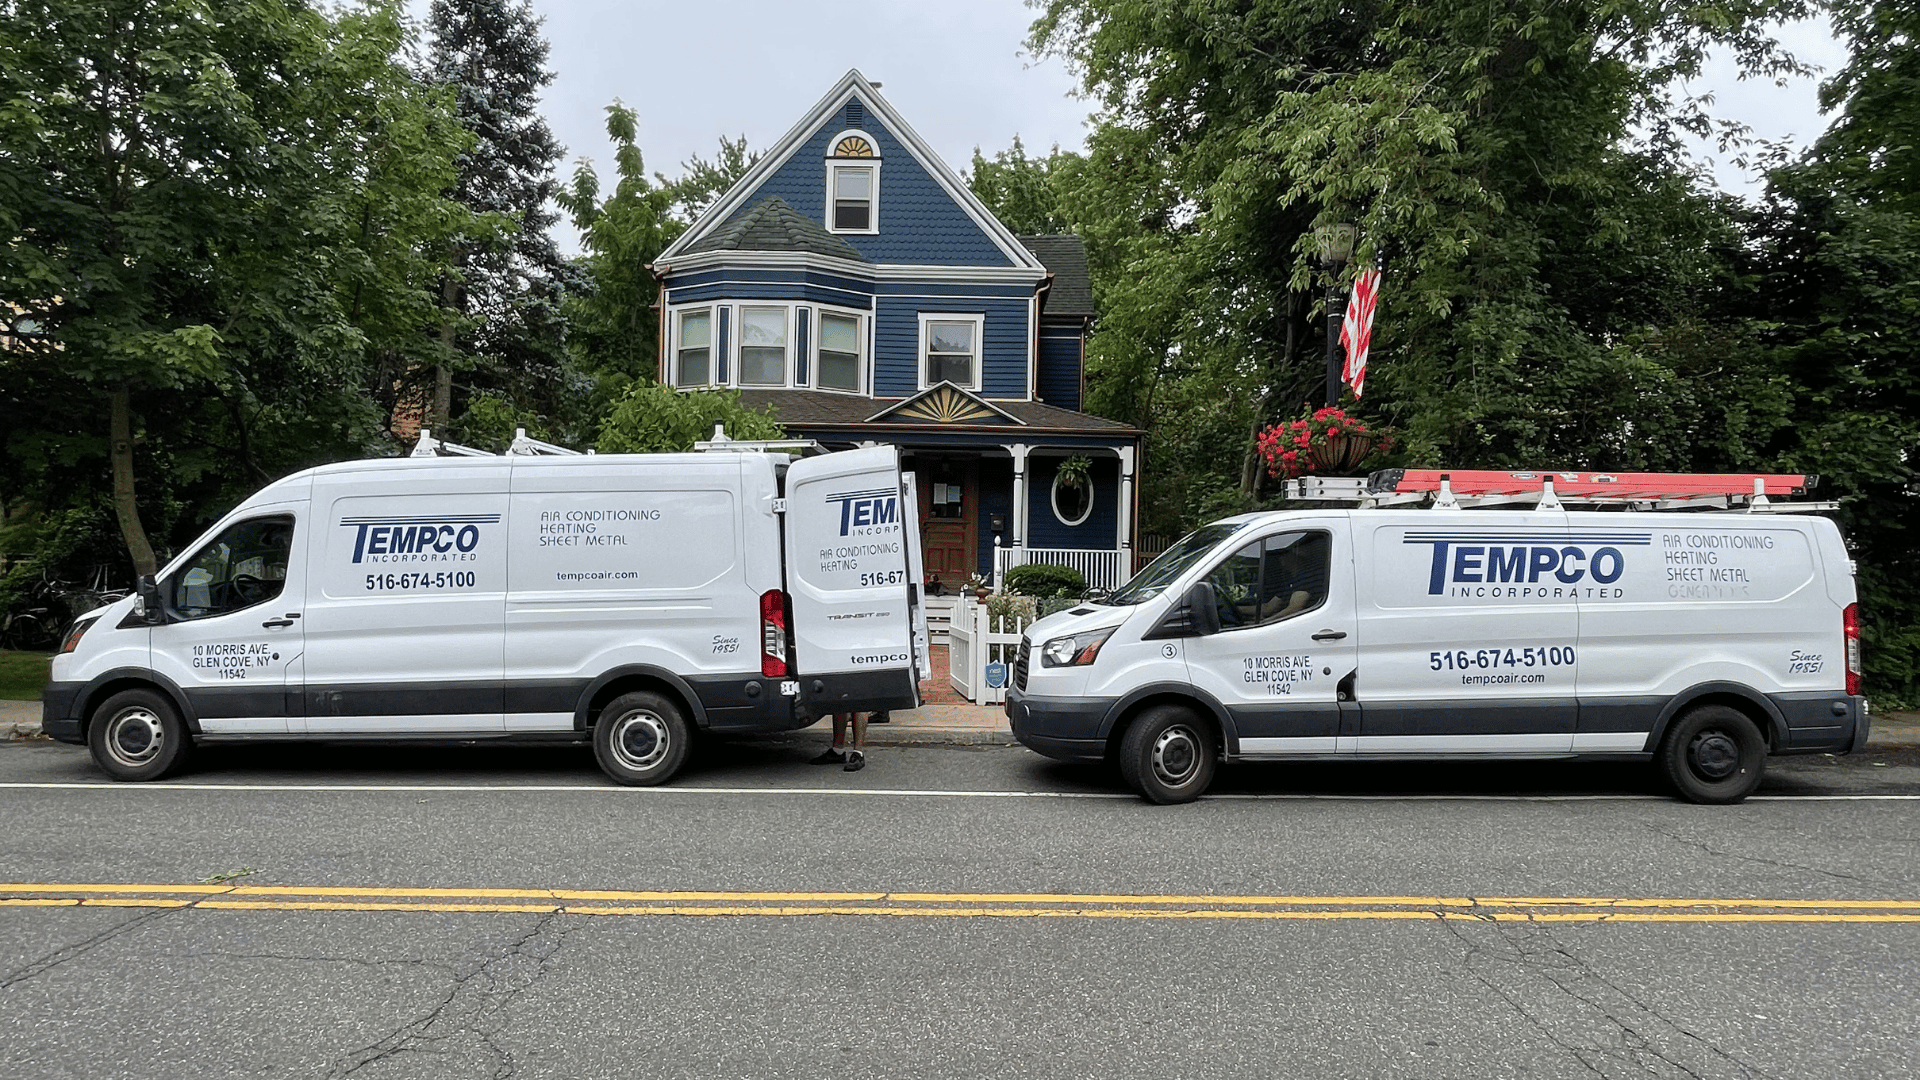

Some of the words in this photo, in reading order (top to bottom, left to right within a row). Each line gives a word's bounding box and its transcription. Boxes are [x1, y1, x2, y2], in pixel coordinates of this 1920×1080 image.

[540, 511, 560, 521] AIR
[566, 509, 661, 521] CONDITIONING
[839, 497, 899, 536] TEM
[540, 523, 597, 534] HEATING
[852, 525, 899, 537] INCORP
[350, 521, 480, 564] TEMPCO
[539, 535, 580, 546] SHEET
[585, 534, 628, 546] METAL
[1662, 534, 1682, 548] AIR
[1686, 535, 1774, 549] CONDITIONING
[820, 548, 833, 560] AIR
[836, 542, 899, 558] CONDITIONING
[366, 553, 477, 563] INCORPORATED
[1664, 551, 1718, 565] HEATING
[820, 559, 858, 573] HEATING
[1428, 541, 1625, 595] TEMPCO
[365, 571, 476, 590] 516-674-5100
[556, 570, 638, 581] tempcoair.com
[860, 570, 904, 586] 516-67
[1666, 567, 1704, 582] SHEET
[1710, 568, 1750, 582] METAL
[1451, 587, 1624, 598] INCORPORATED
[1668, 584, 1750, 599] GENERS
[827, 612, 875, 620] TRANSIT
[712, 634, 738, 644] Since
[193, 645, 203, 656] 10
[206, 644, 246, 655] MORRIS
[248, 643, 271, 655] AVE.
[1790, 650, 1822, 661] Since
[192, 657, 220, 668] GLEN
[222, 656, 254, 668] COVE,
[256, 656, 271, 667] NY
[850, 653, 908, 664] tempco
[1243, 657, 1253, 669] 10
[1255, 656, 1291, 669] MORRIS
[1292, 655, 1313, 668] AVE.
[1429, 646, 1576, 671] 516-674-5100
[218, 668, 246, 679] 11542
[1243, 671, 1269, 683] GLEN
[1271, 670, 1299, 682] COVE,
[1300, 669, 1313, 681] NY
[1461, 672, 1545, 686] tempcoair.com
[1267, 683, 1291, 695] 11542
